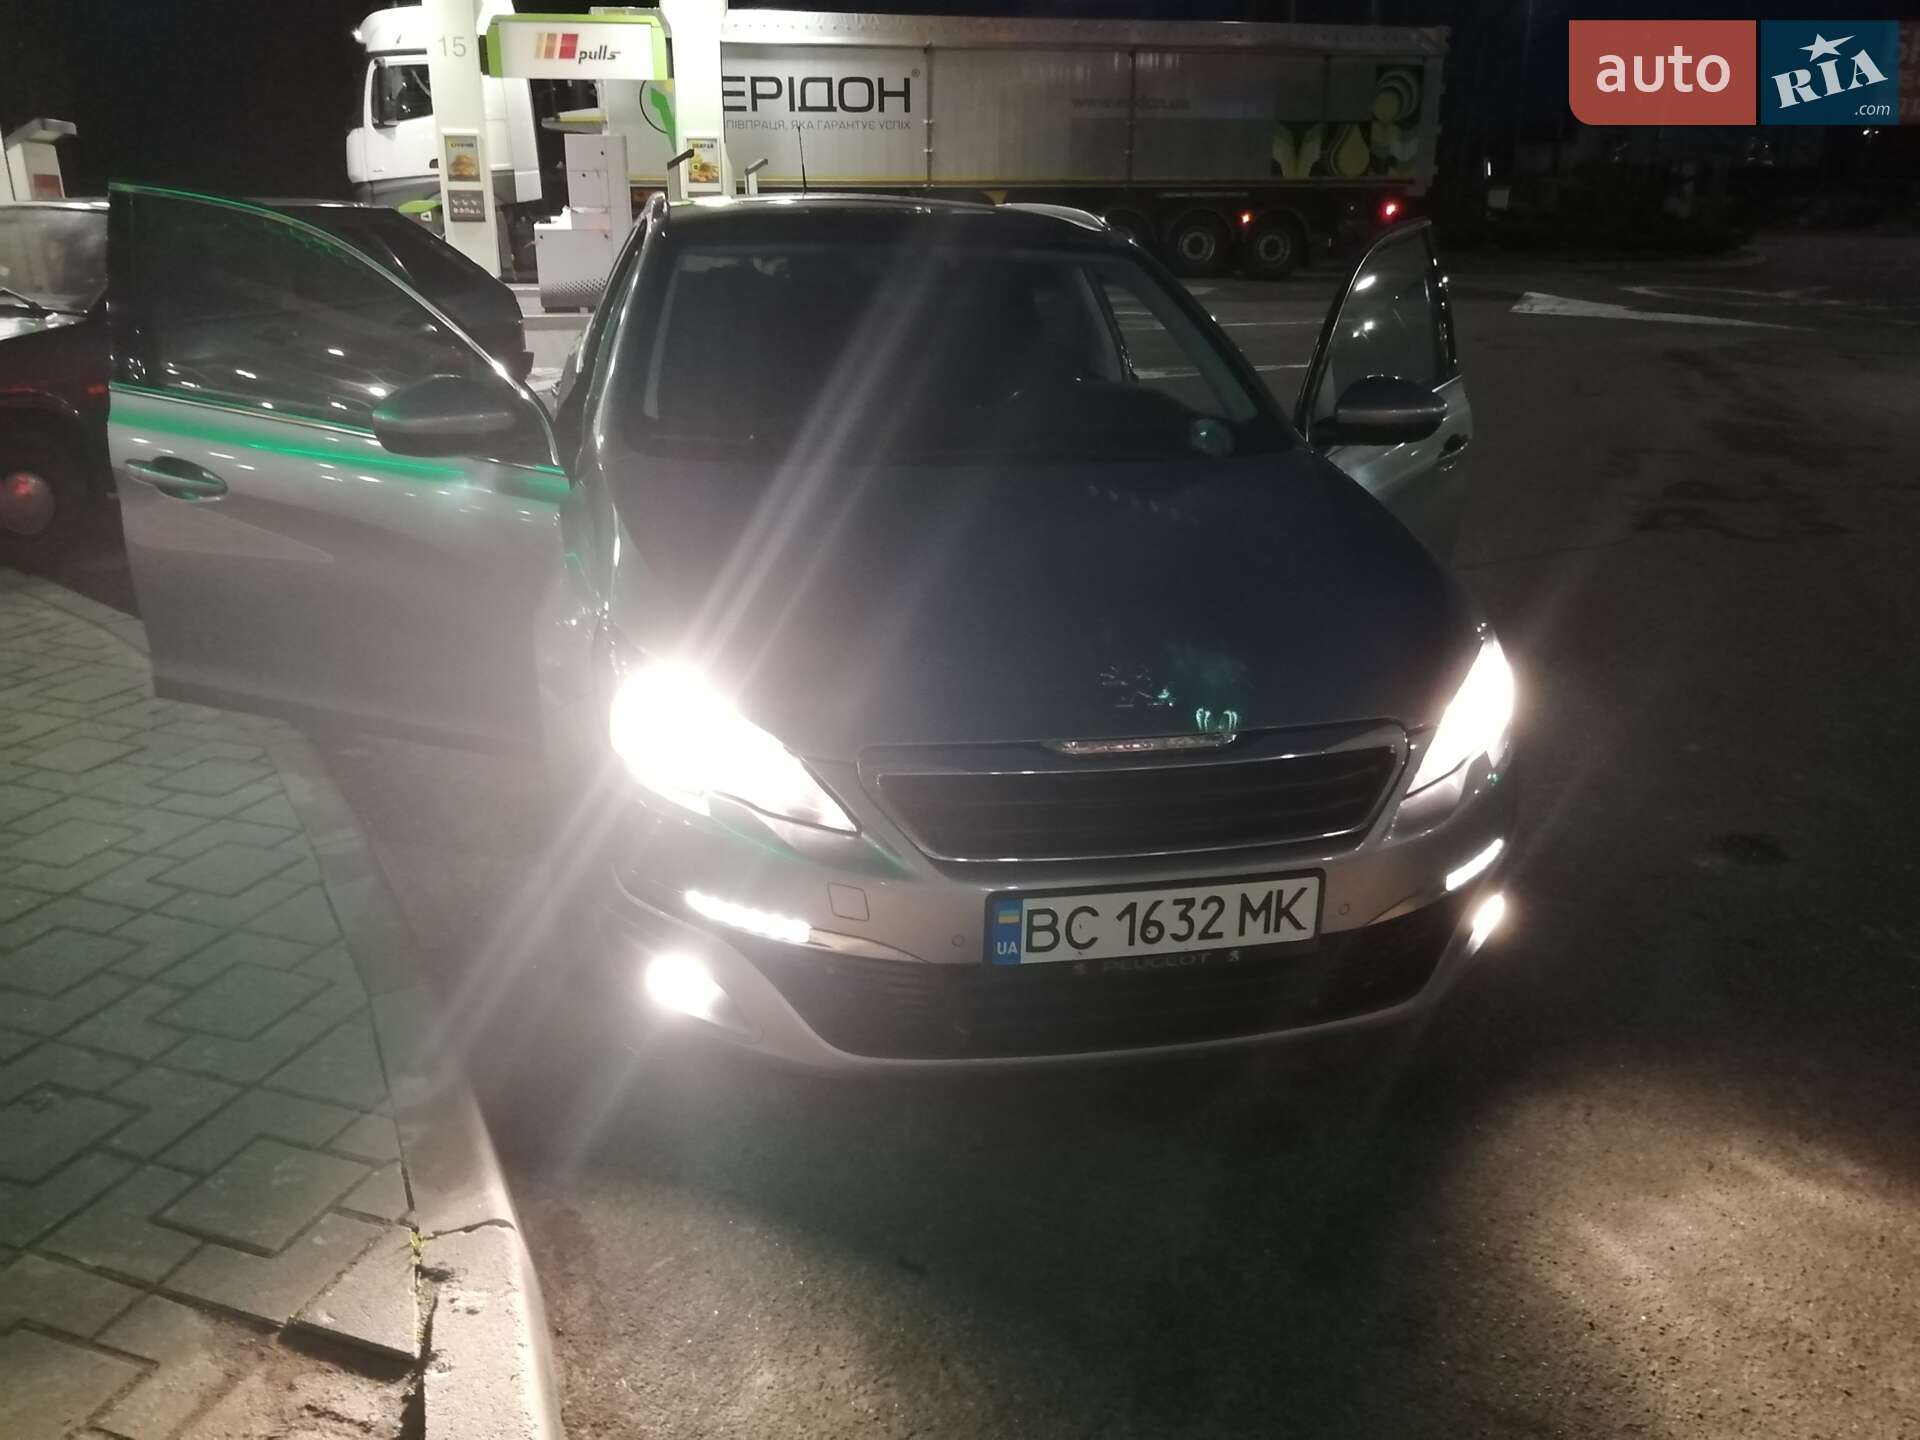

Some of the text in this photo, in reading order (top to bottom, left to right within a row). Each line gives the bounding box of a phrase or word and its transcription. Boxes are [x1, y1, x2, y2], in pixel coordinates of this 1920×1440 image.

[437, 36, 467, 58] 15
[578, 45, 621, 64] pulls
[791, 119, 814, 129] ЯКА
[1025, 887, 1308, 953] BC 1632 MK
[997, 942, 1018, 955] UA
